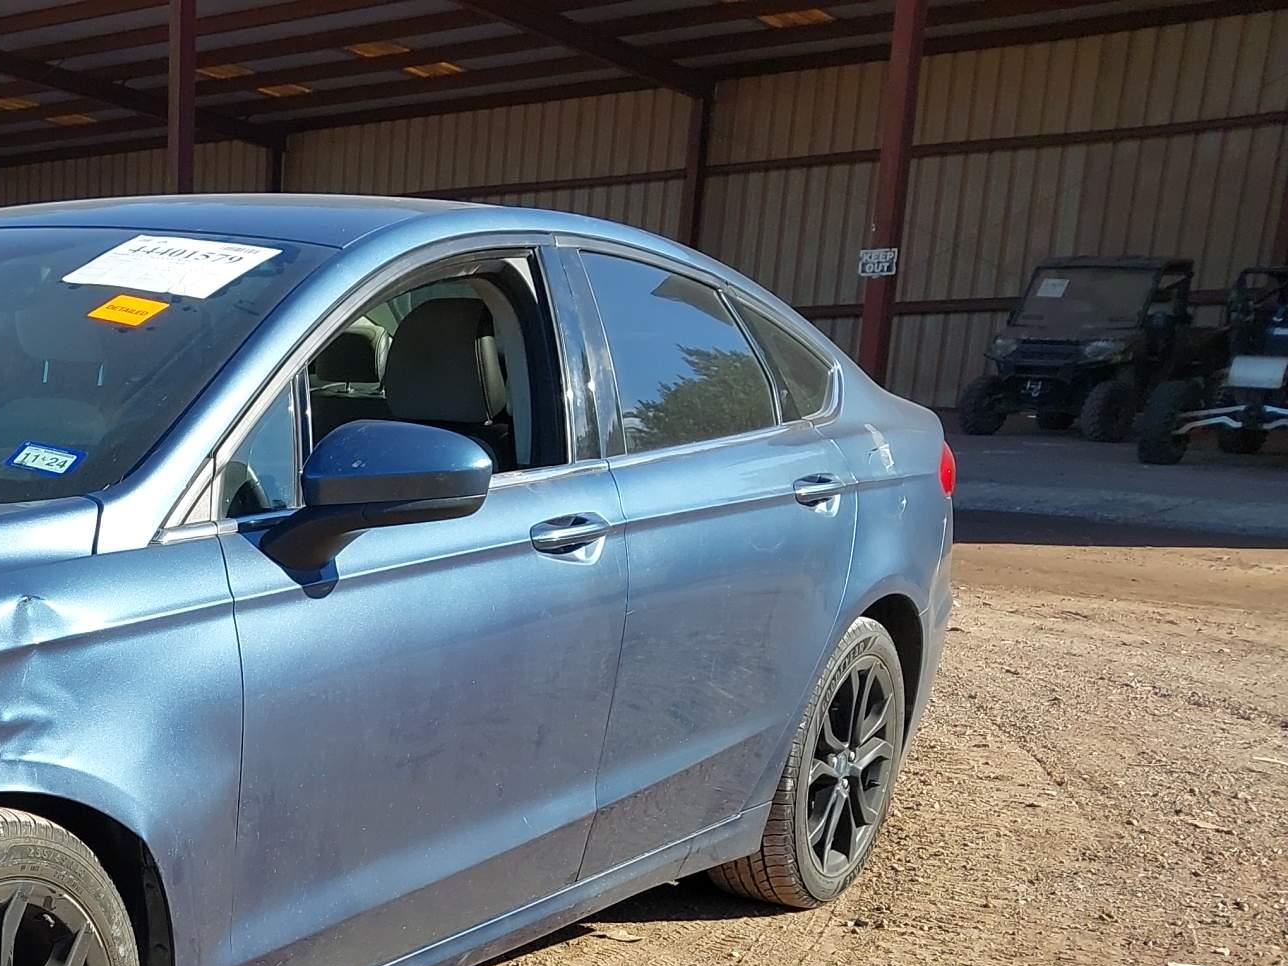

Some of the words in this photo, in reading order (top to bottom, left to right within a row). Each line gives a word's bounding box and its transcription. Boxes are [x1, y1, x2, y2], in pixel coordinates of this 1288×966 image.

[128, 245, 244, 264] 44401579
[863, 251, 894, 263] KEEP
[865, 262, 890, 273] OUT
[105, 304, 150, 316] DETAILED
[20, 452, 41, 464] 11
[44, 457, 68, 469] 24
